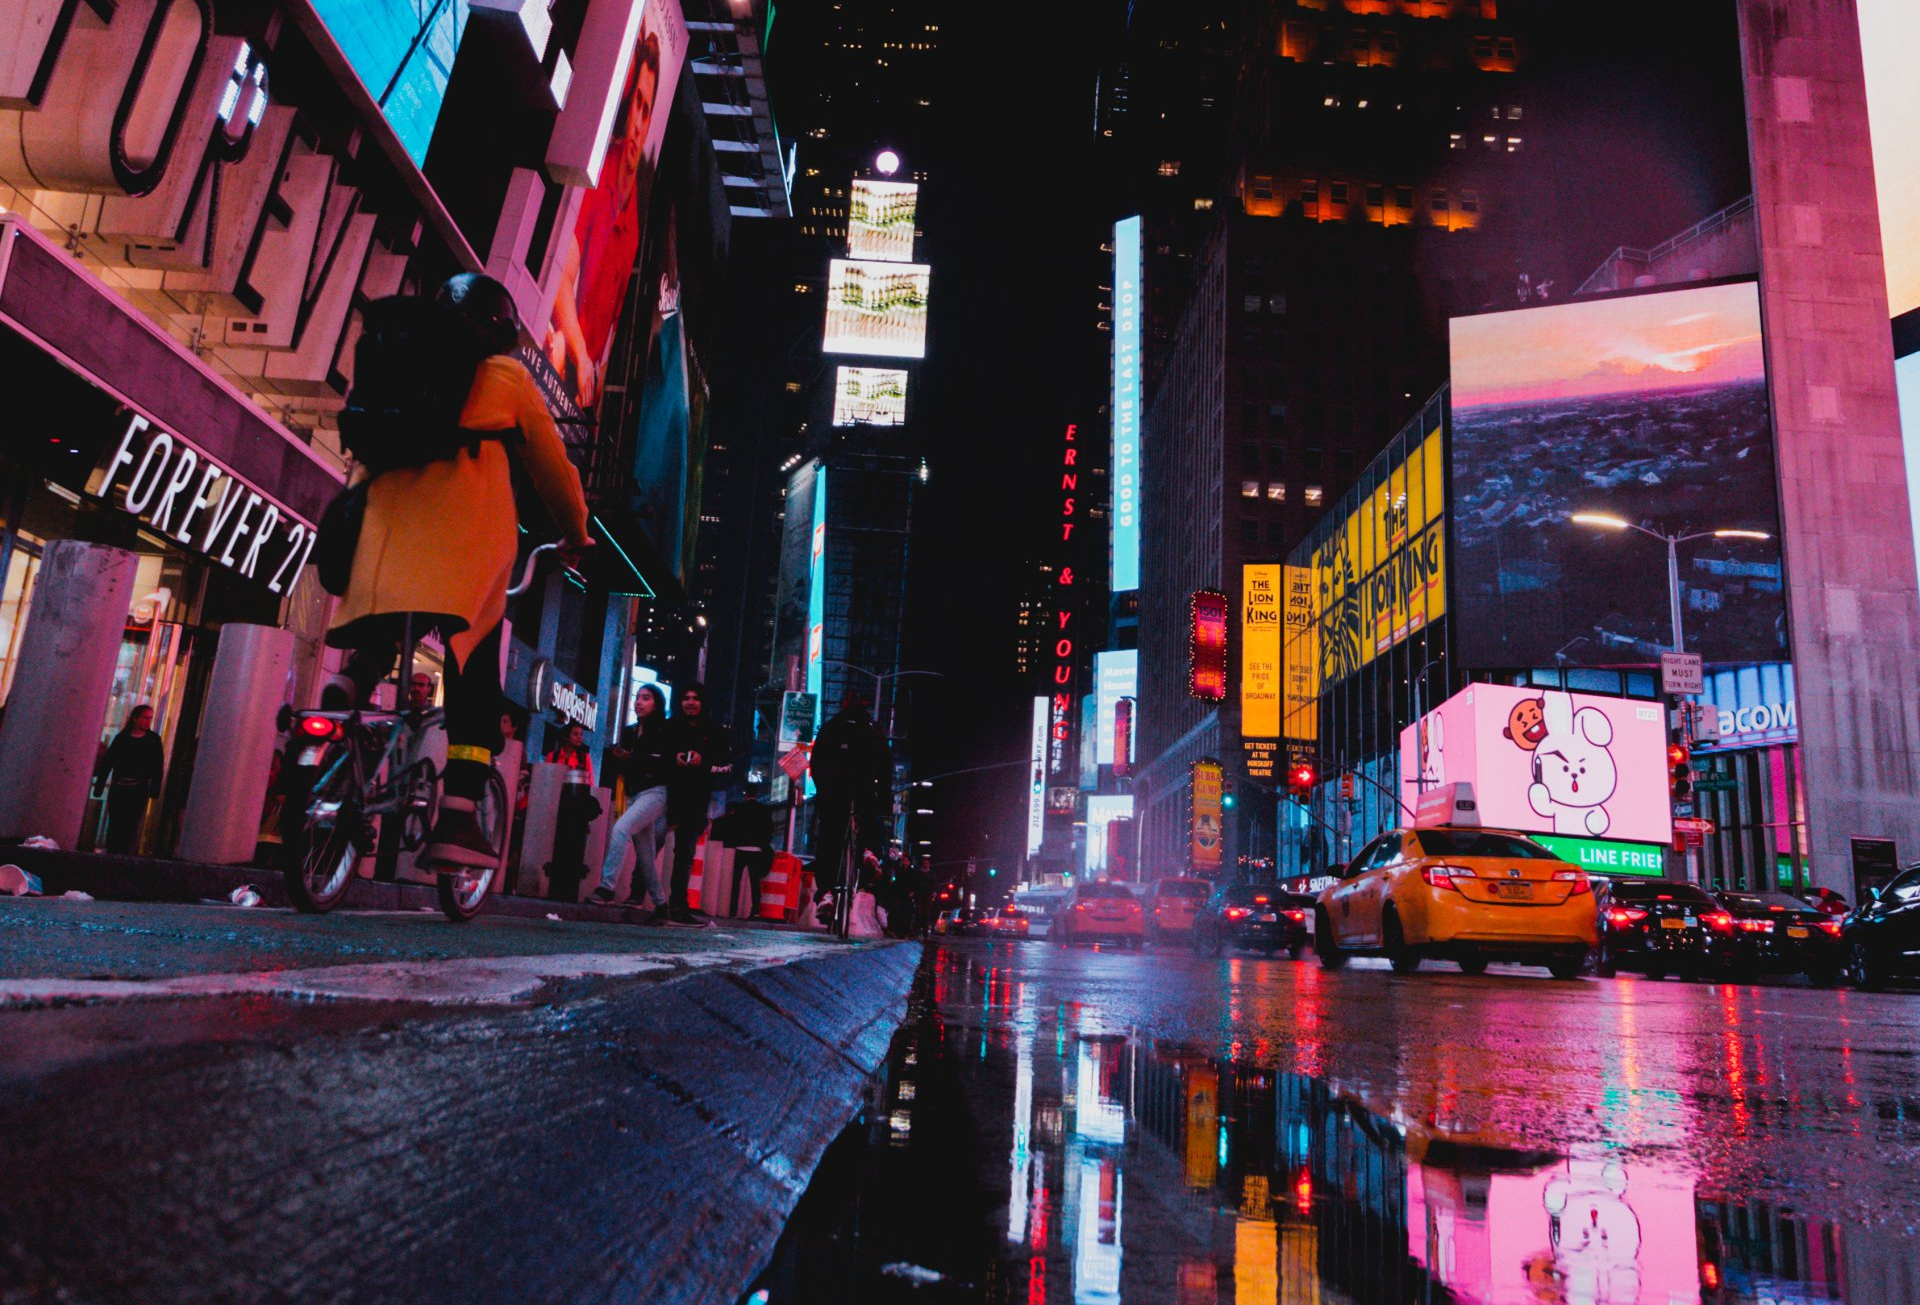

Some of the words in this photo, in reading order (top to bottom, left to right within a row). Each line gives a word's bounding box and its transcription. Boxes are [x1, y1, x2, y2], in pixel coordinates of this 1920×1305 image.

[1121, 280, 1132, 332] DROP
[522, 346, 542, 373] LIVE
[1121, 344, 1132, 392] LAST
[1121, 399, 1132, 435] THE
[1121, 438, 1132, 467] TO
[1062, 424, 1077, 541] ERNST
[97, 414, 279, 579] FOREVER
[268, 524, 317, 598] 21
[1120, 474, 1132, 527] GOOD
[1383, 506, 1406, 542] THE
[1059, 567, 1074, 586] &
[1251, 580, 1270, 589] THE
[1365, 563, 1396, 640] LION
[1398, 531, 1438, 616] KING
[1248, 590, 1274, 605] LION
[1198, 605, 1222, 618] 1501
[1246, 606, 1278, 624] KING
[1249, 662, 1260, 671] SEE
[1262, 662, 1273, 671] THE
[1672, 669, 1694, 677] MUST
[1053, 611, 1071, 741] YOUNG
[1252, 672, 1269, 680] PRIDE
[1245, 692, 1276, 700] BROADWAY
[552, 681, 585, 725] sunglass
[584, 693, 598, 732] hut
[786, 718, 810, 727] South
[1255, 743, 1277, 751] TICKETS
[1195, 767, 1221, 782] BUBBA
[1249, 768, 1272, 777] THEATRE
[1196, 782, 1219, 795] GUMP
[1580, 848, 1617, 865] LINE
